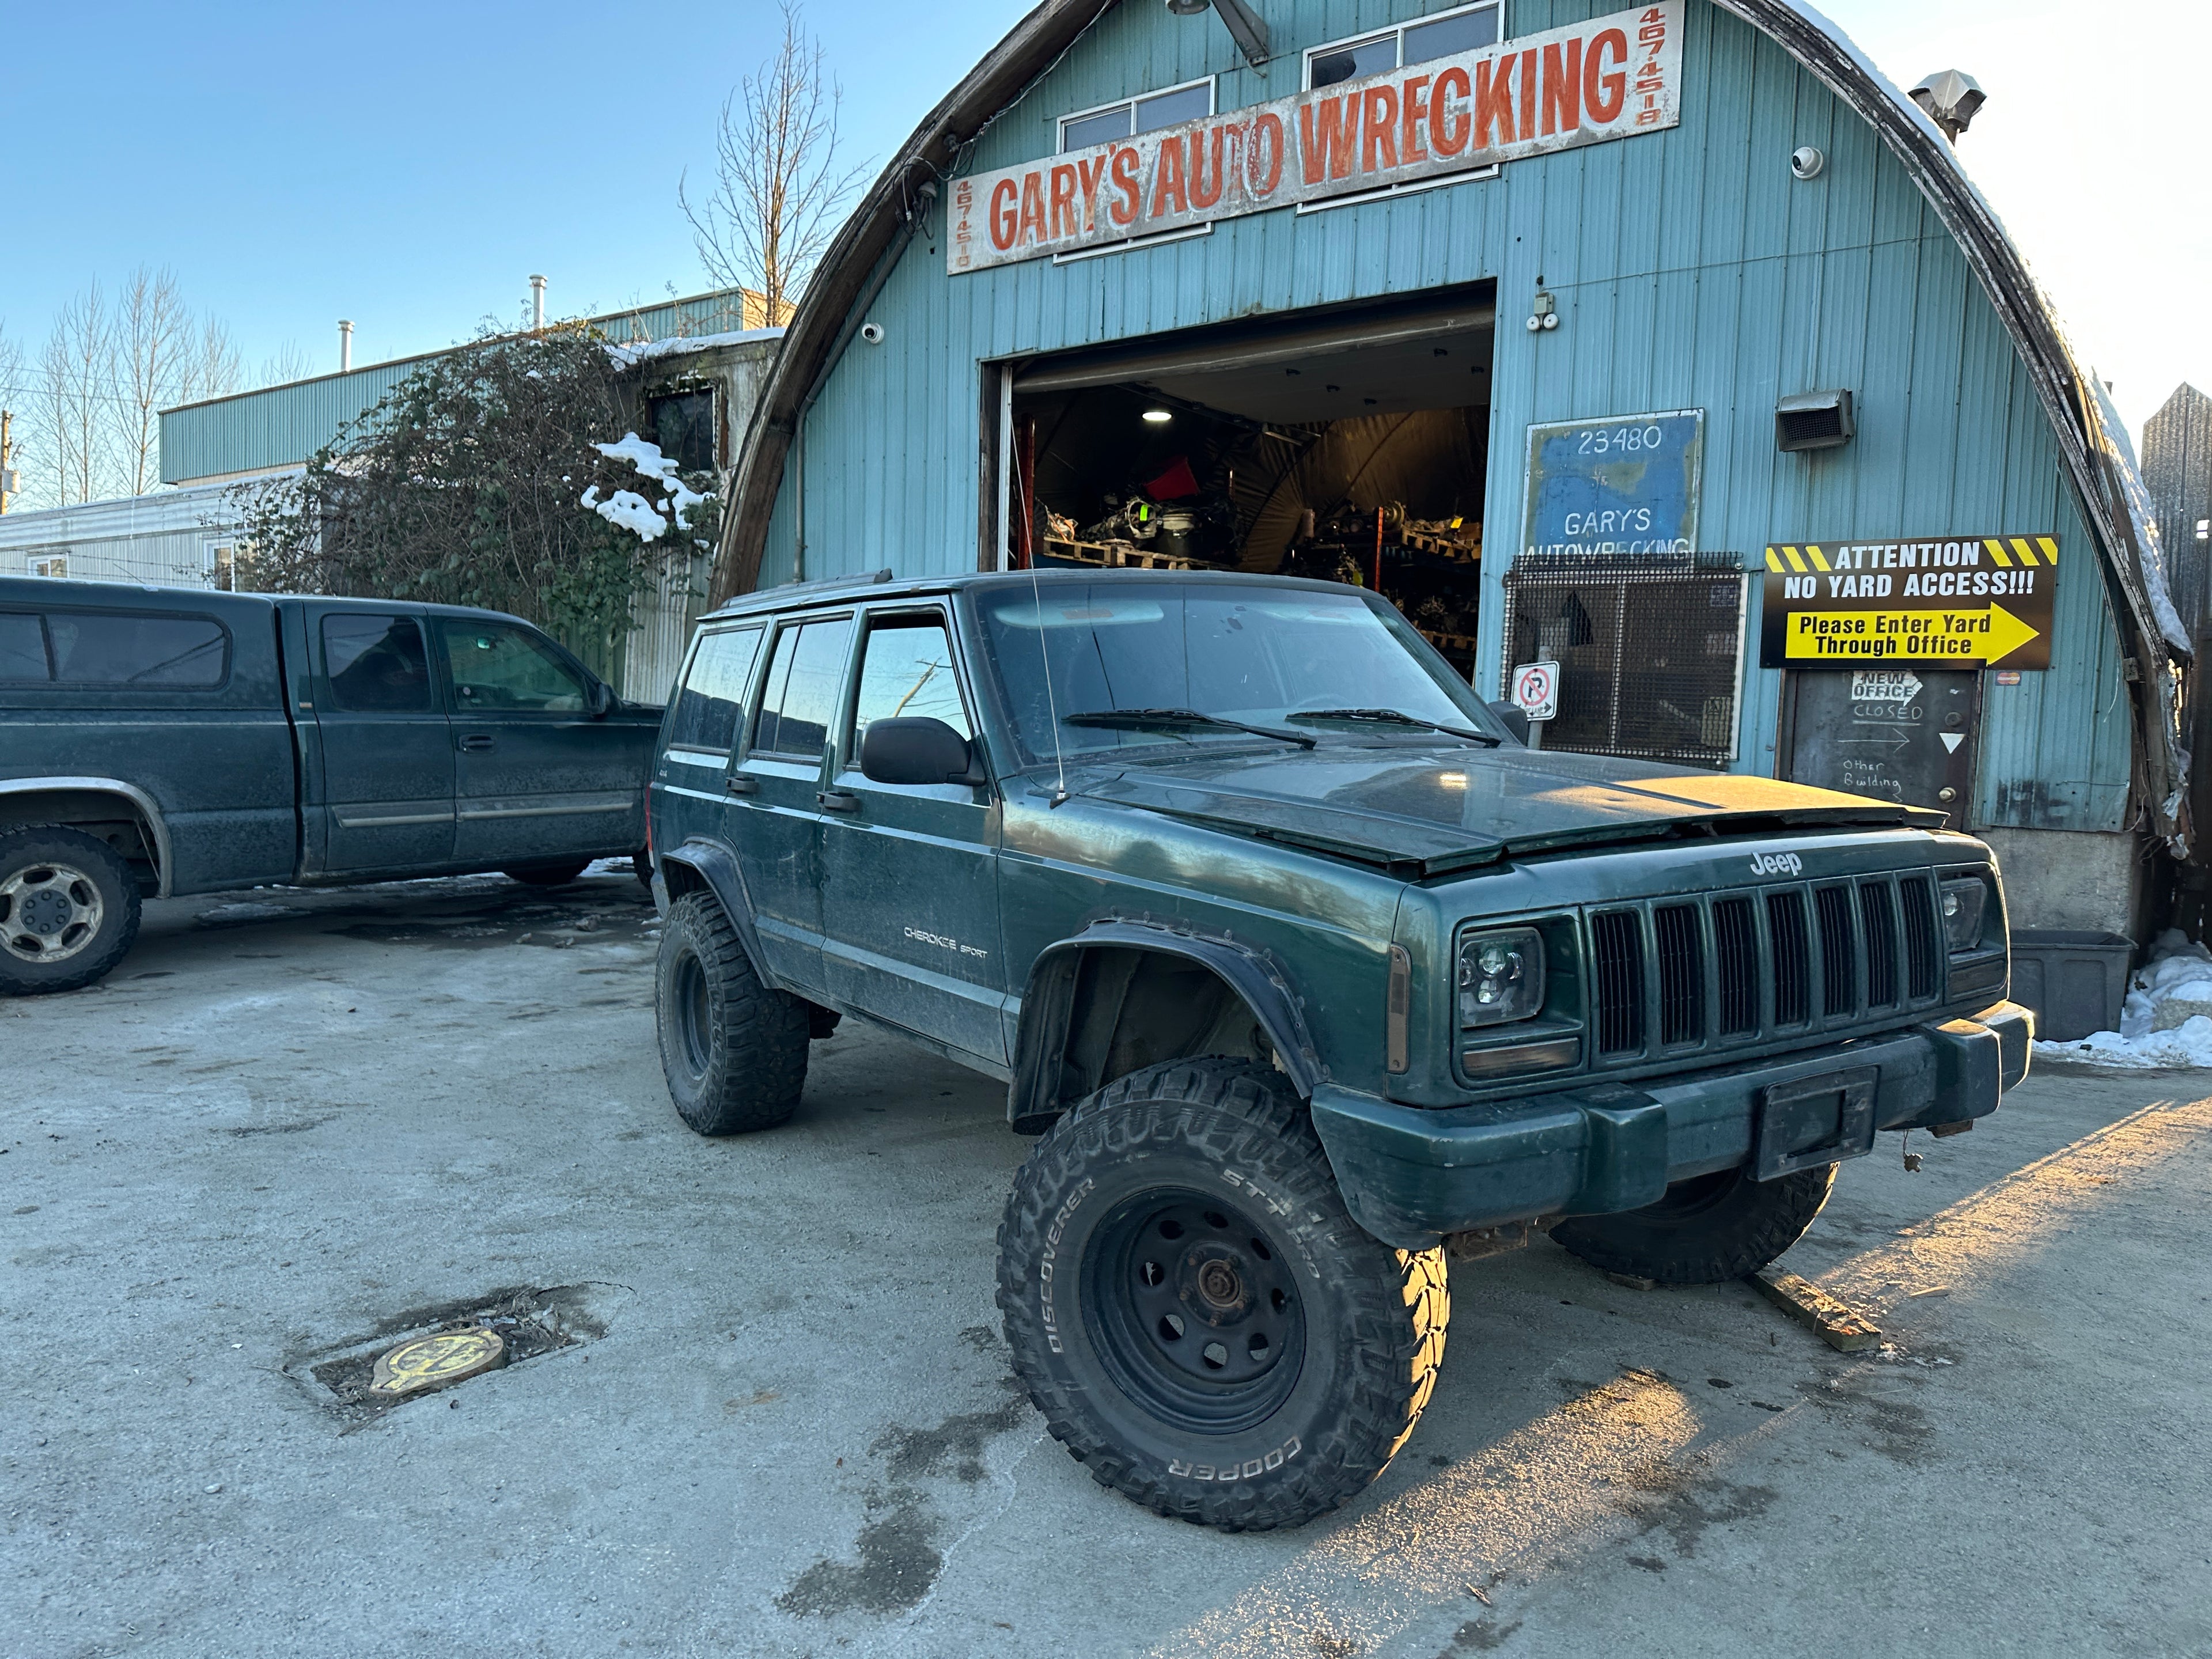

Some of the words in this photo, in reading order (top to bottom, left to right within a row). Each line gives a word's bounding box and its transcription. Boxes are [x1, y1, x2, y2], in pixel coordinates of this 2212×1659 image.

[990, 145, 1140, 251] GARY'S
[1152, 113, 1283, 217] AUTO
[1300, 28, 1628, 184] WRECKING
[1578, 426, 1662, 454] 23480
[1565, 508, 1651, 535] GARY'S
[1835, 541, 1980, 569] ATTENTION
[1785, 576, 1817, 599] NO
[1828, 574, 1892, 598] YARD
[1903, 570, 2035, 596] ACCESS!!!
[1800, 616, 1865, 634] Please
[1876, 615, 1932, 633] Enter
[1943, 613, 1991, 633] Yard
[1815, 635, 1897, 657] Through
[1907, 635, 1972, 654] Office
[1854, 683, 1914, 697] OFFICE
[1863, 672, 1904, 684] NEW
[1854, 704, 1923, 719] CLOSED
[1844, 772, 1902, 795] Building
[1750, 851, 1802, 876] Jeep
[904, 926, 957, 950] CHEROKEE
[960, 944, 988, 959] SPORT
[1040, 1177, 1097, 1354] DISCOVERER
[1168, 1435, 1302, 1482] COOPER
